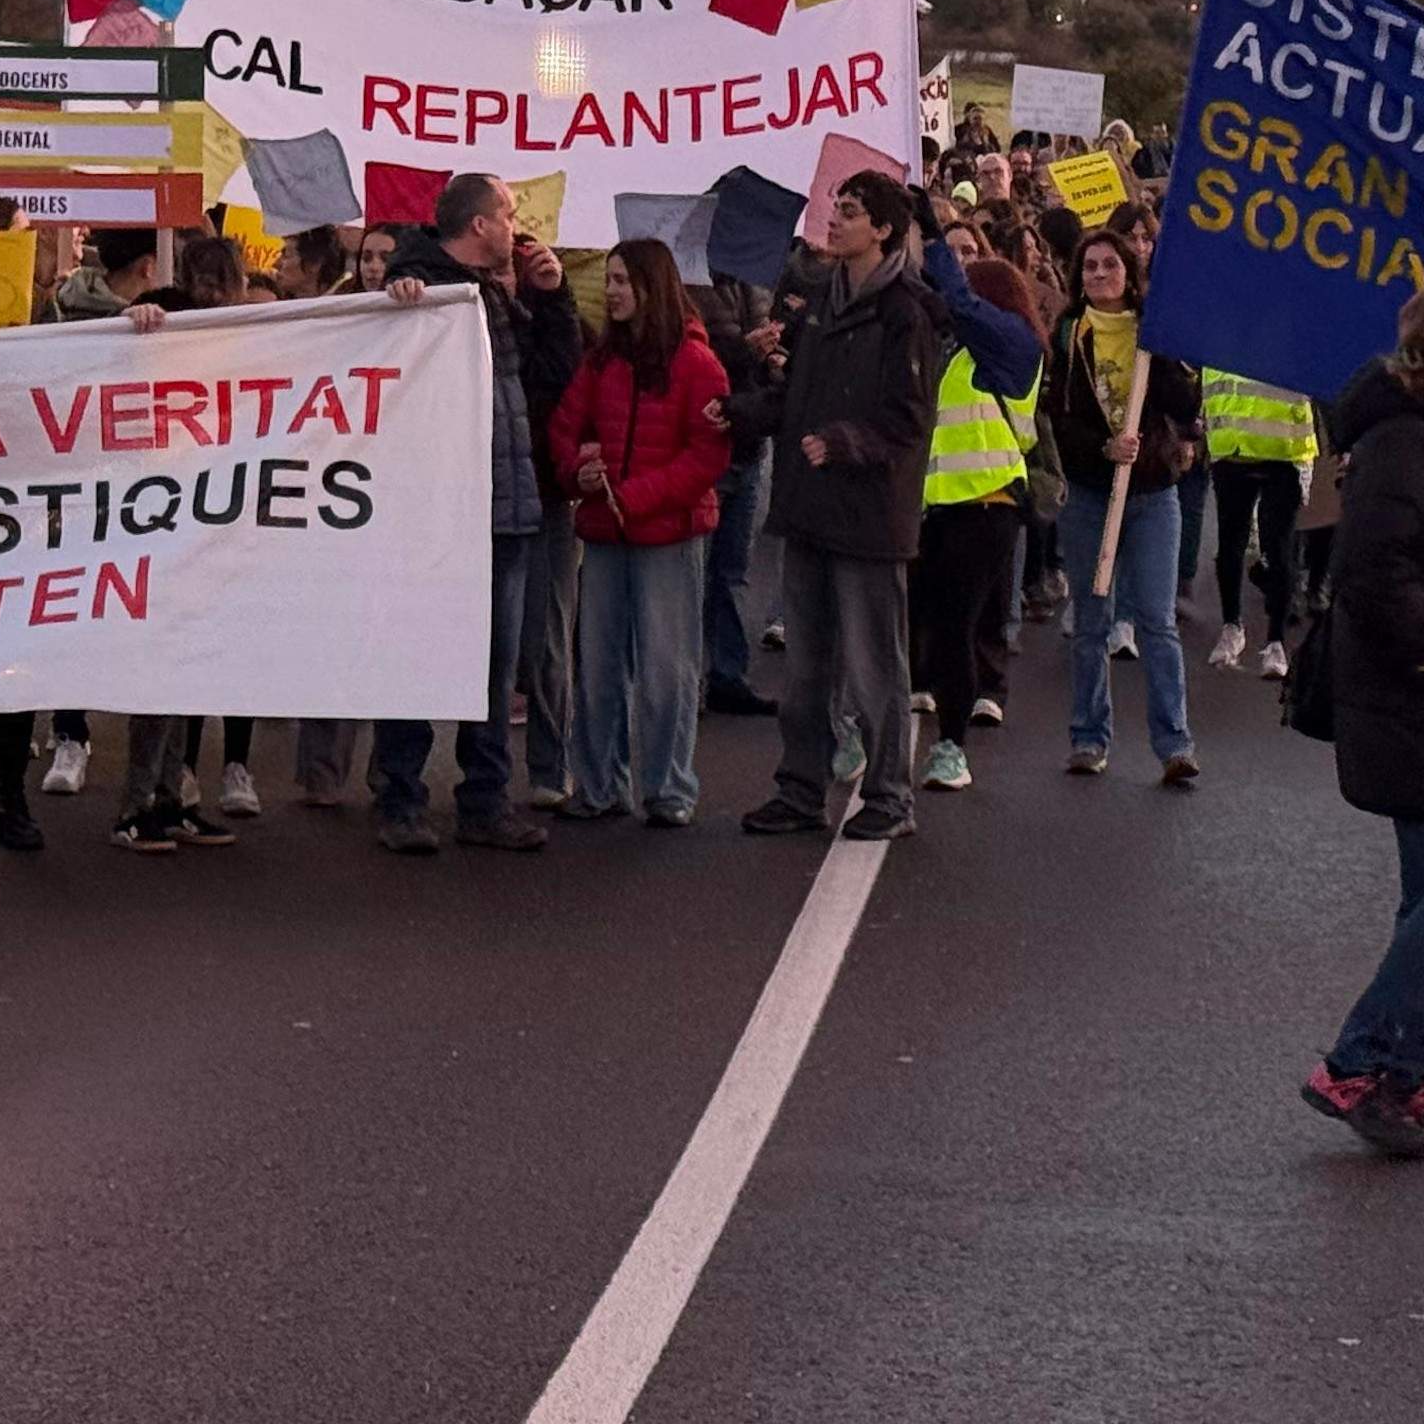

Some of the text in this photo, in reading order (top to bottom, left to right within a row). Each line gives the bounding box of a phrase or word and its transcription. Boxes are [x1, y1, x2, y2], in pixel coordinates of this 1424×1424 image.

[0, 71, 69, 89] DOCENTS
[202, 28, 888, 153] CAL REPLANTEJAR
[1199, 100, 1409, 219] GRAN
[30, 367, 402, 454] VERITAT
